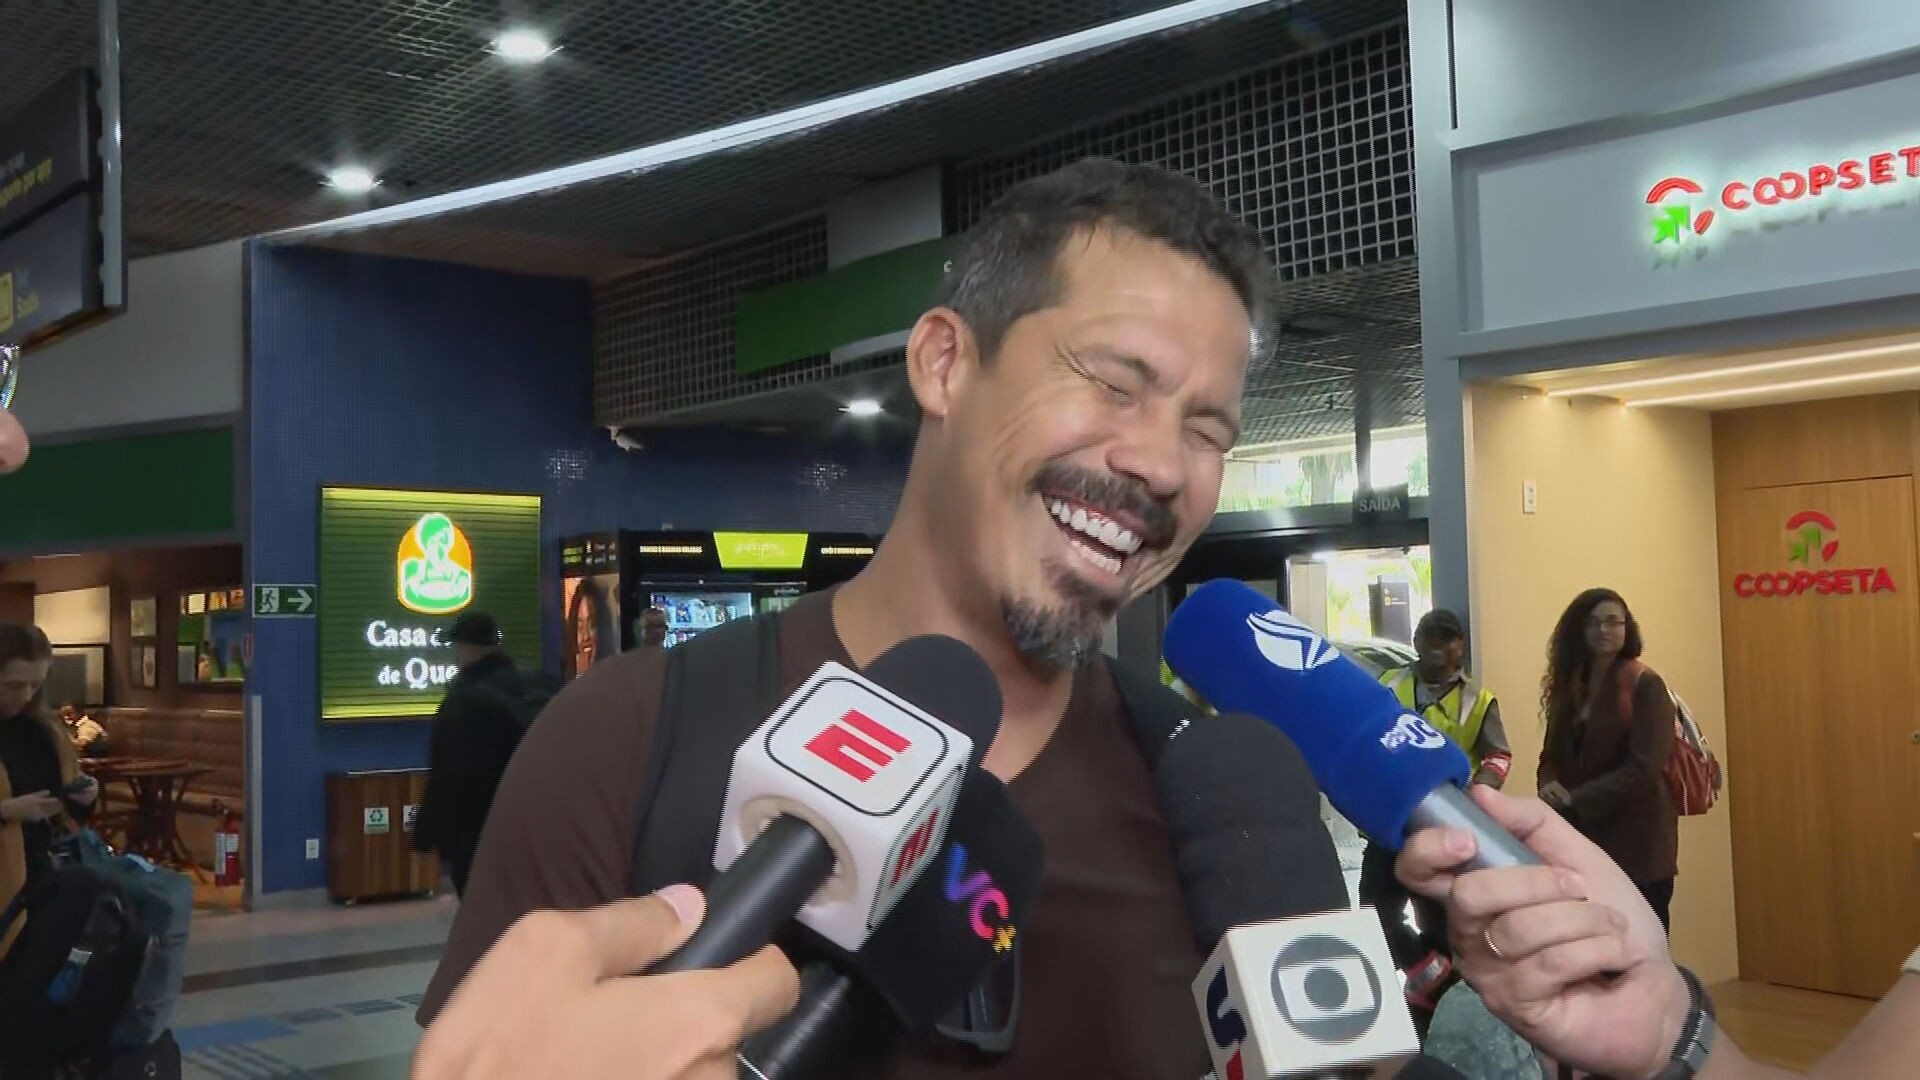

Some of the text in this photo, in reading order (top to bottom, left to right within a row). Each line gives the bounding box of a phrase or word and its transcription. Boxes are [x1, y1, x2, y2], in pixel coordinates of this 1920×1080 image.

[1733, 567, 1897, 598] COOPSETA
[366, 620, 427, 647] Casa
[377, 665, 400, 685] de
